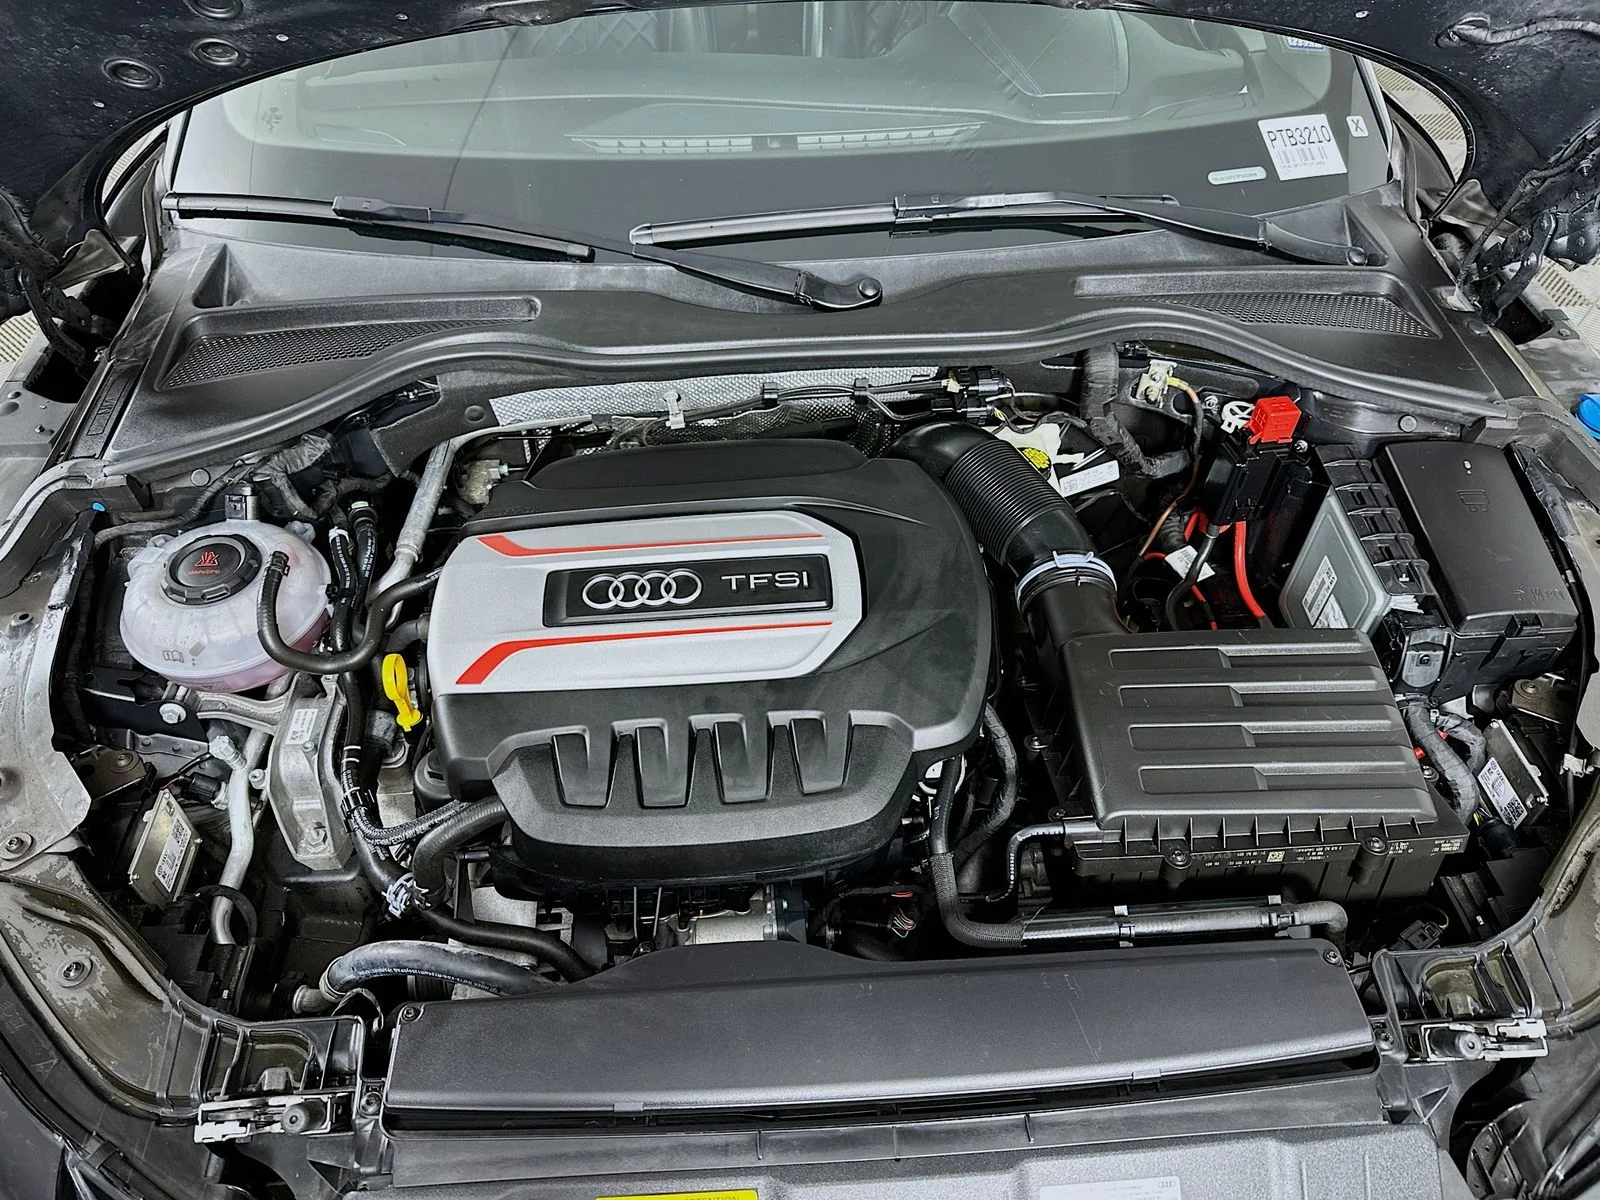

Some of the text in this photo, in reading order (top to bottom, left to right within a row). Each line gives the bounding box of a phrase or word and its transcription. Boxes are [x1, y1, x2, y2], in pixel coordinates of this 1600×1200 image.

[1351, 119, 1364, 132] X
[1267, 125, 1331, 149] PTB3210
[721, 571, 809, 591] TFSI
